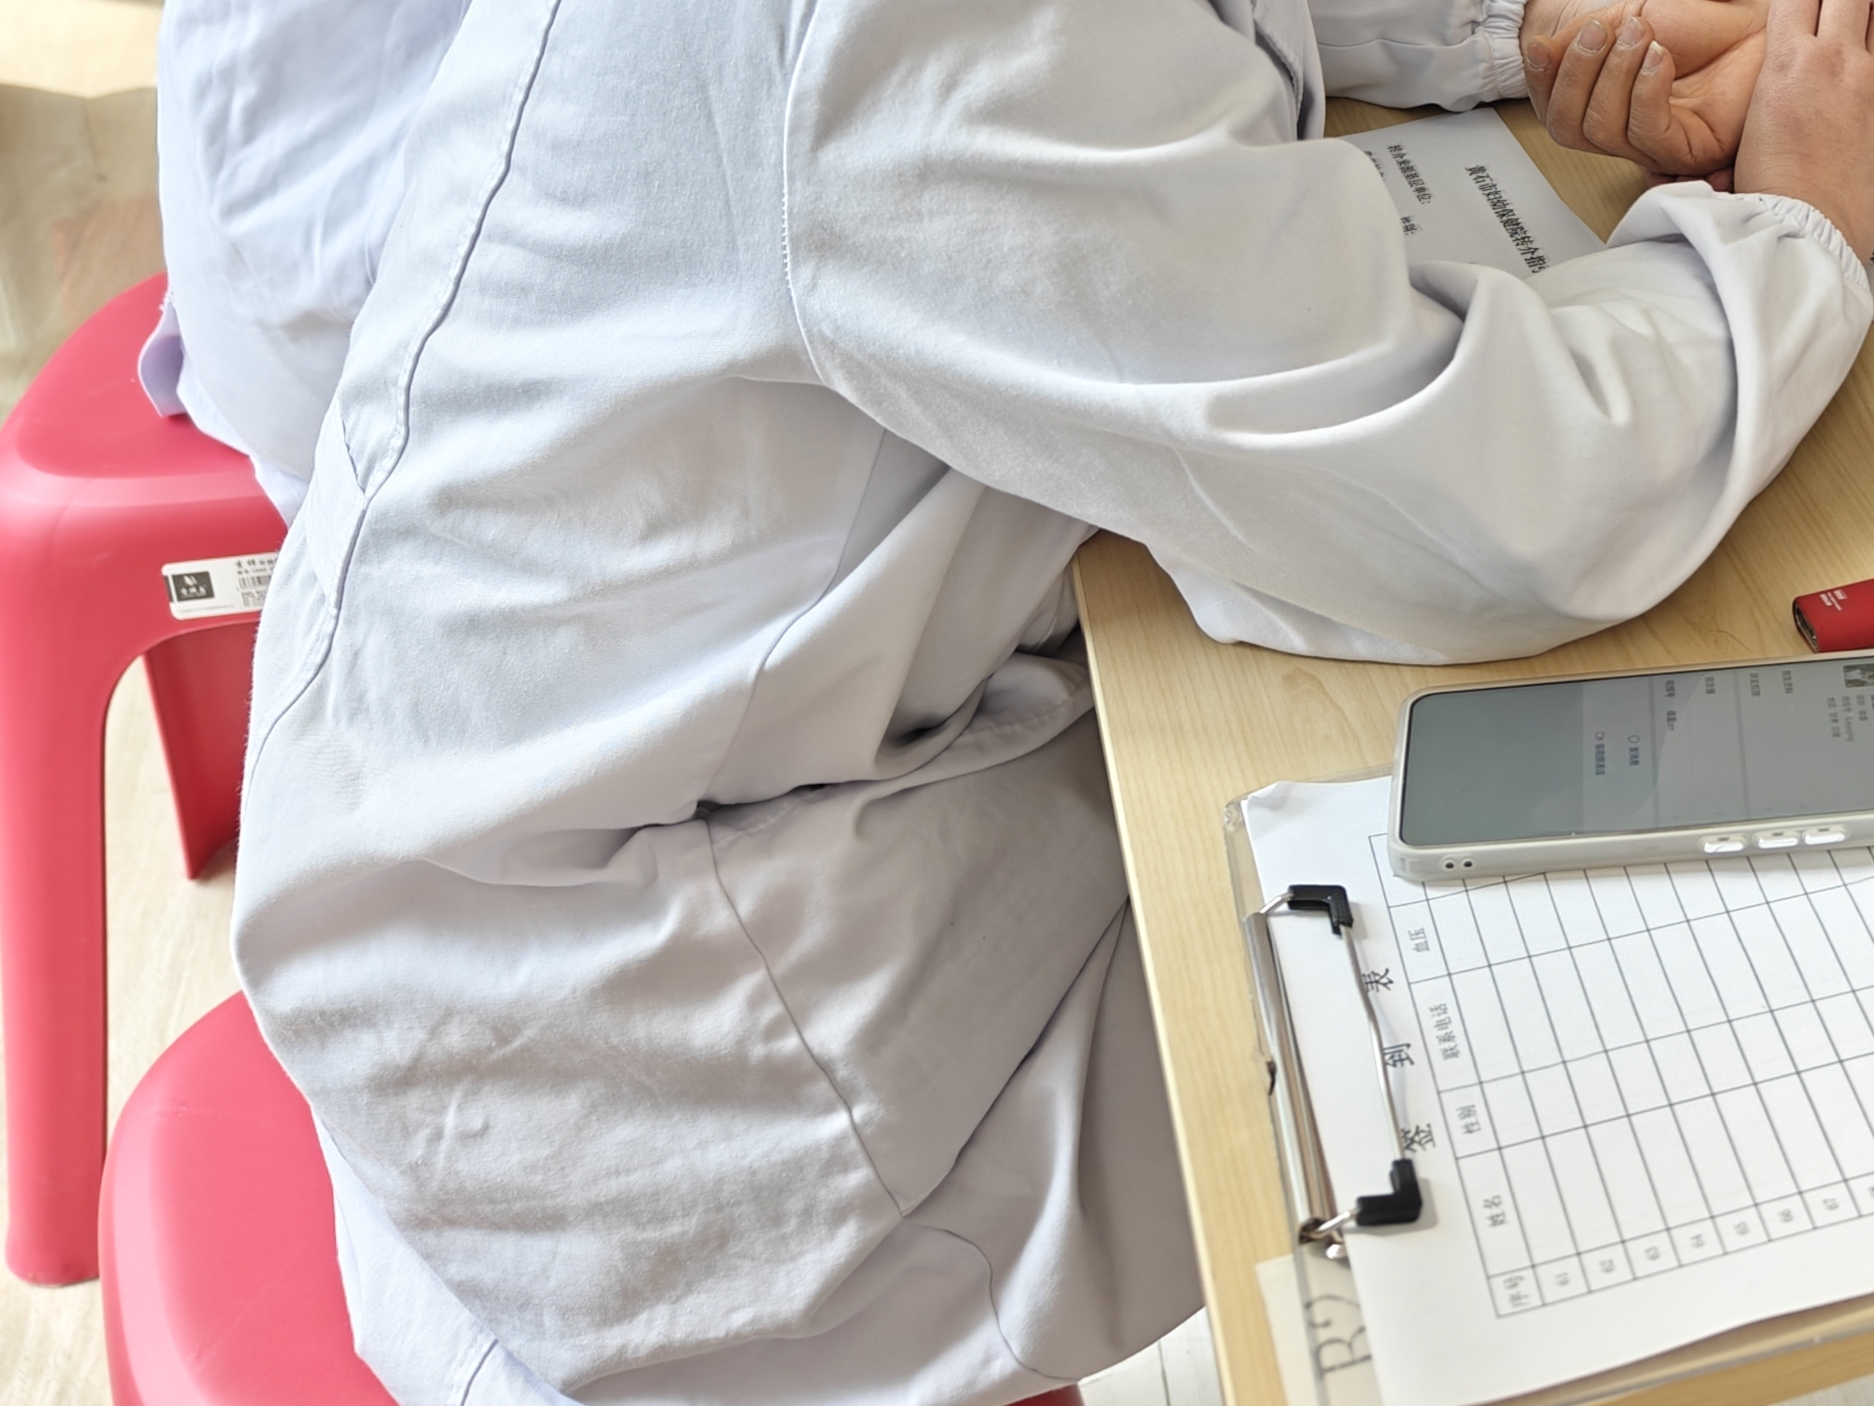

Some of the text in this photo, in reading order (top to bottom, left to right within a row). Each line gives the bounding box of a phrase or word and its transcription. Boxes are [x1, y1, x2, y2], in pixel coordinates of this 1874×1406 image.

[1411, 926, 1431, 955] 血压
[1428, 1002, 1463, 1061] 联系电话
[1456, 1103, 1483, 1136] 性别
[1483, 1193, 1510, 1230] 姓名
